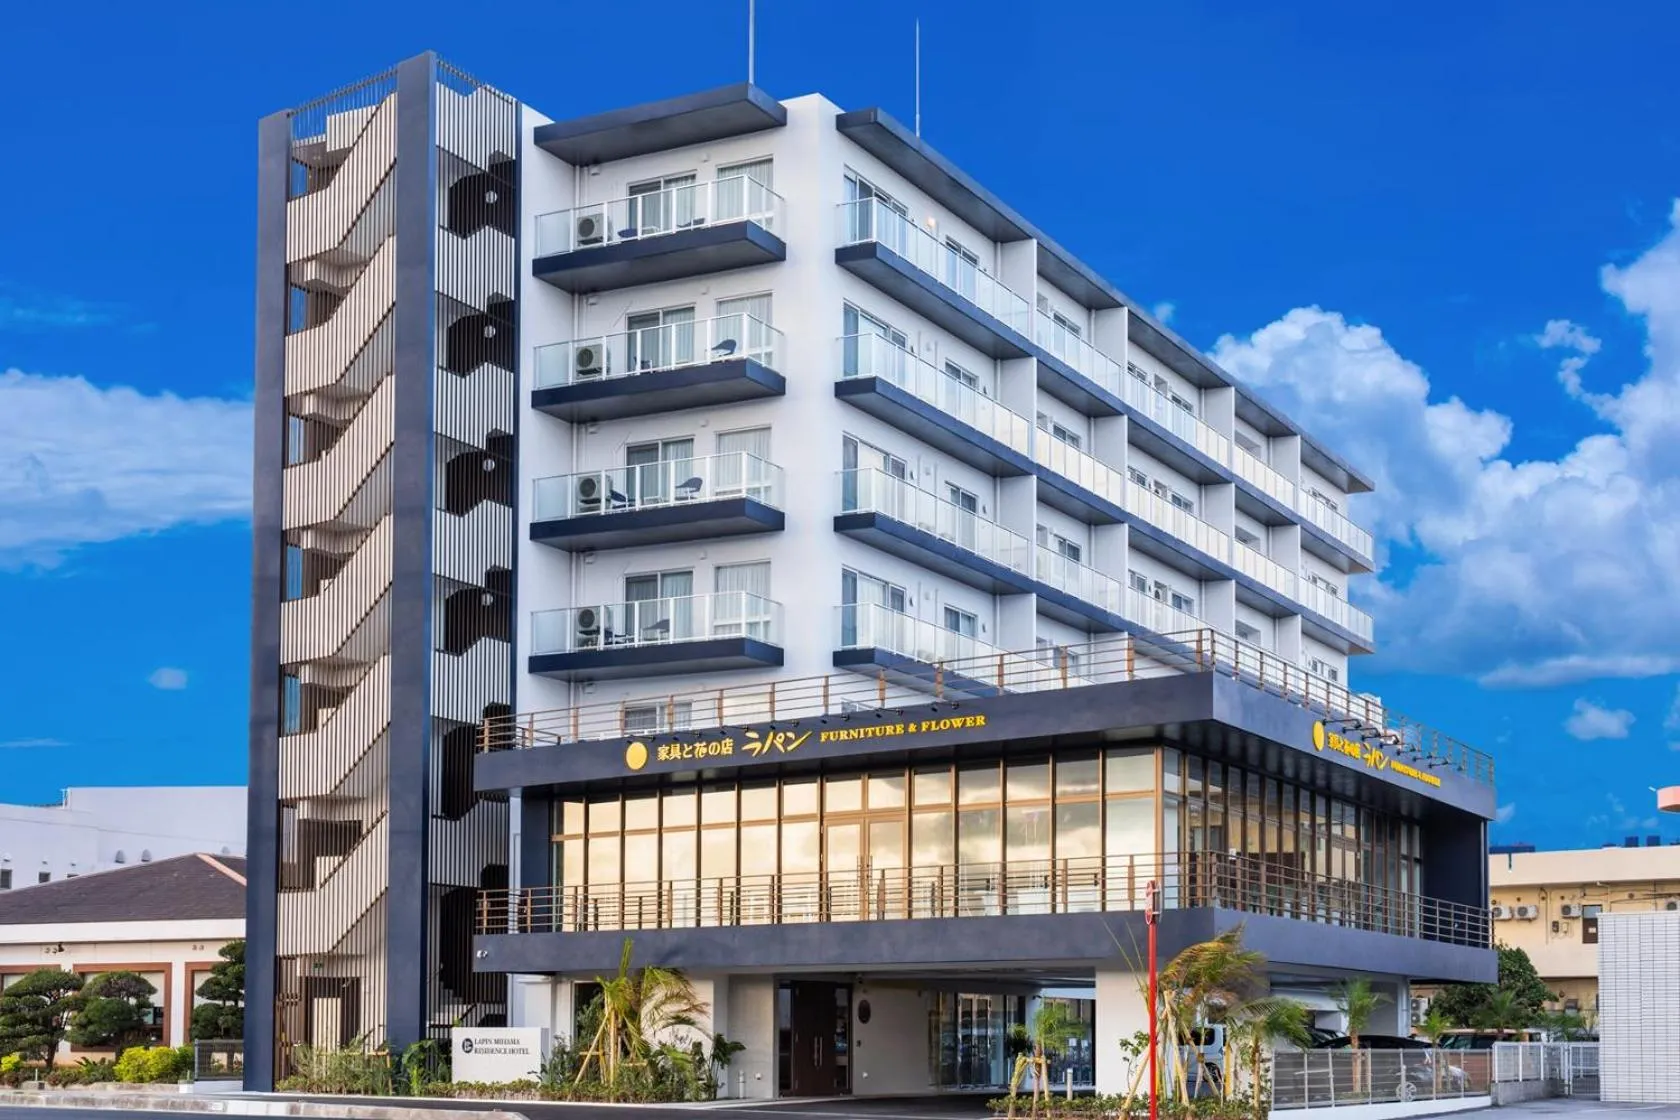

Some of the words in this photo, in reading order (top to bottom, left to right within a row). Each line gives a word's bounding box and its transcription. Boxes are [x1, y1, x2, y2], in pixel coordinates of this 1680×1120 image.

[657, 738, 734, 761] 家具と花の店
[742, 731, 812, 757] ラパン
[820, 723, 905, 743] FURNITURE
[908, 721, 918, 733] &
[920, 715, 986, 732] FLOWER
[508, 1047, 530, 1055] HOTEL
